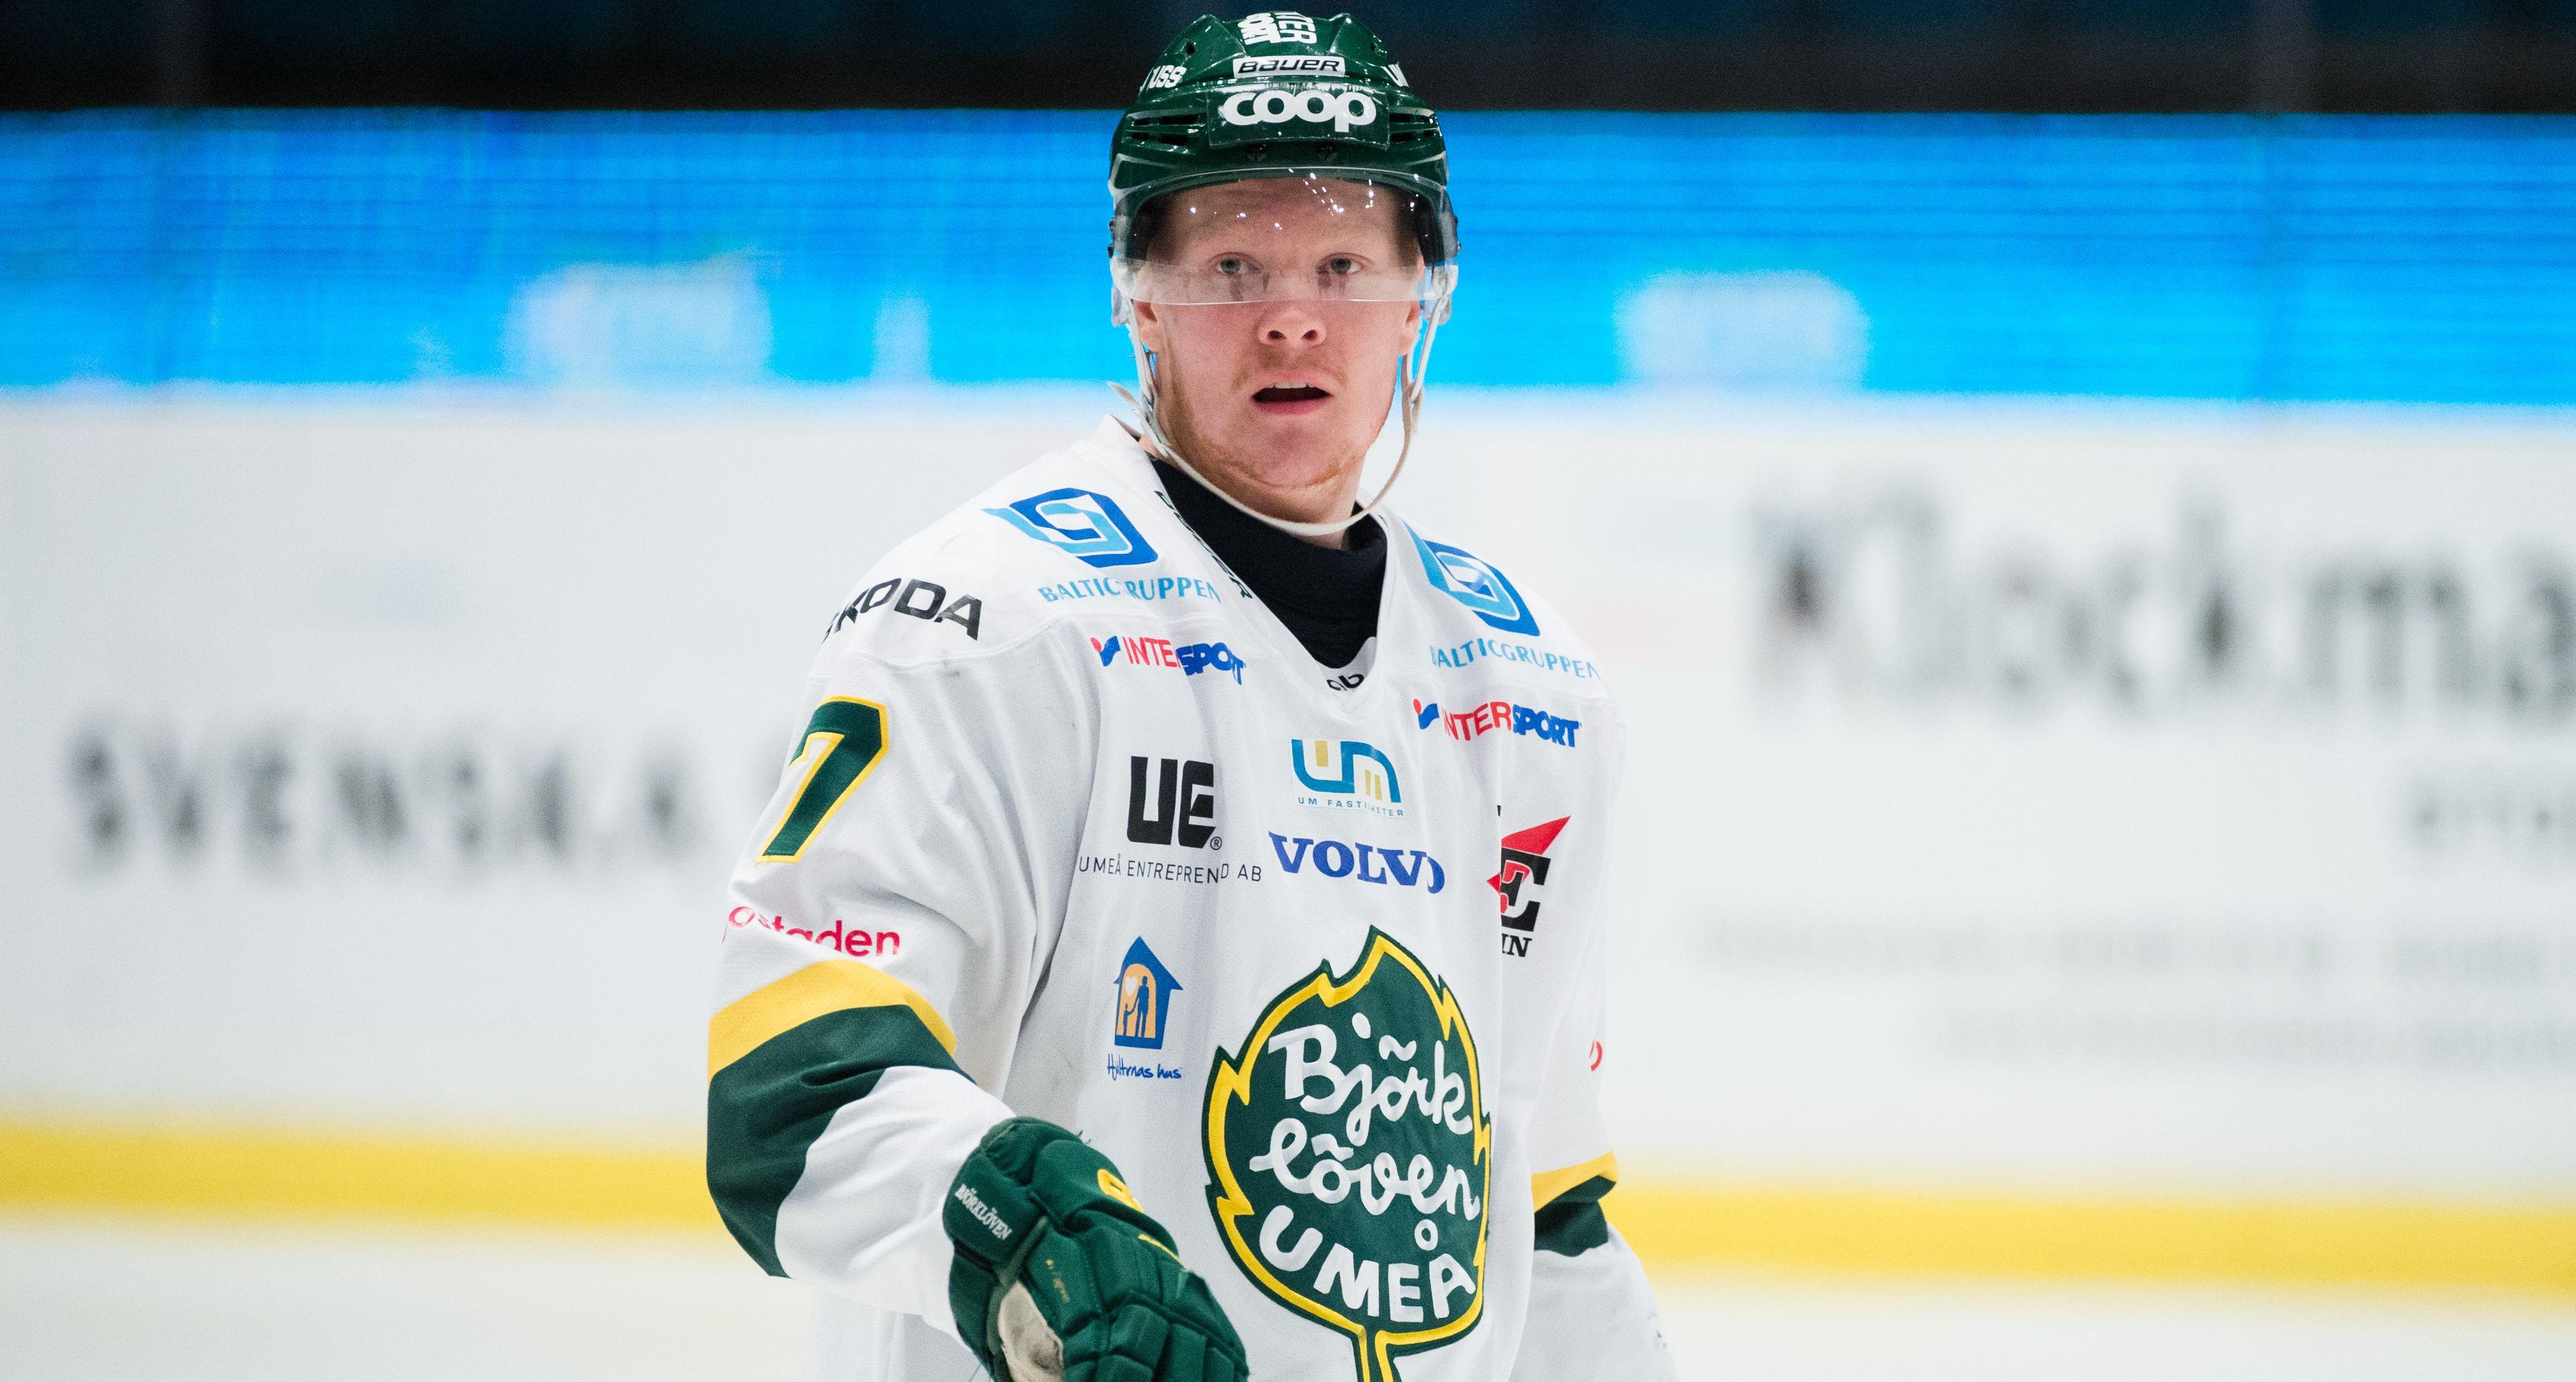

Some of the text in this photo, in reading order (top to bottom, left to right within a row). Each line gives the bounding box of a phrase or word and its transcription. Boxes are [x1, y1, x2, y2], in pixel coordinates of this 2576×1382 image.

[1222, 90, 1377, 133] coop
[1038, 577, 1222, 604] BALTICRUPPEN
[822, 577, 983, 643] KODA
[1298, 797, 1318, 805] UM
[1078, 853, 1262, 884] UMEÅ ENTREPREND AB
[1157, 1063, 1182, 1079] hus
[1259, 1204, 1477, 1323] UMEÅ
